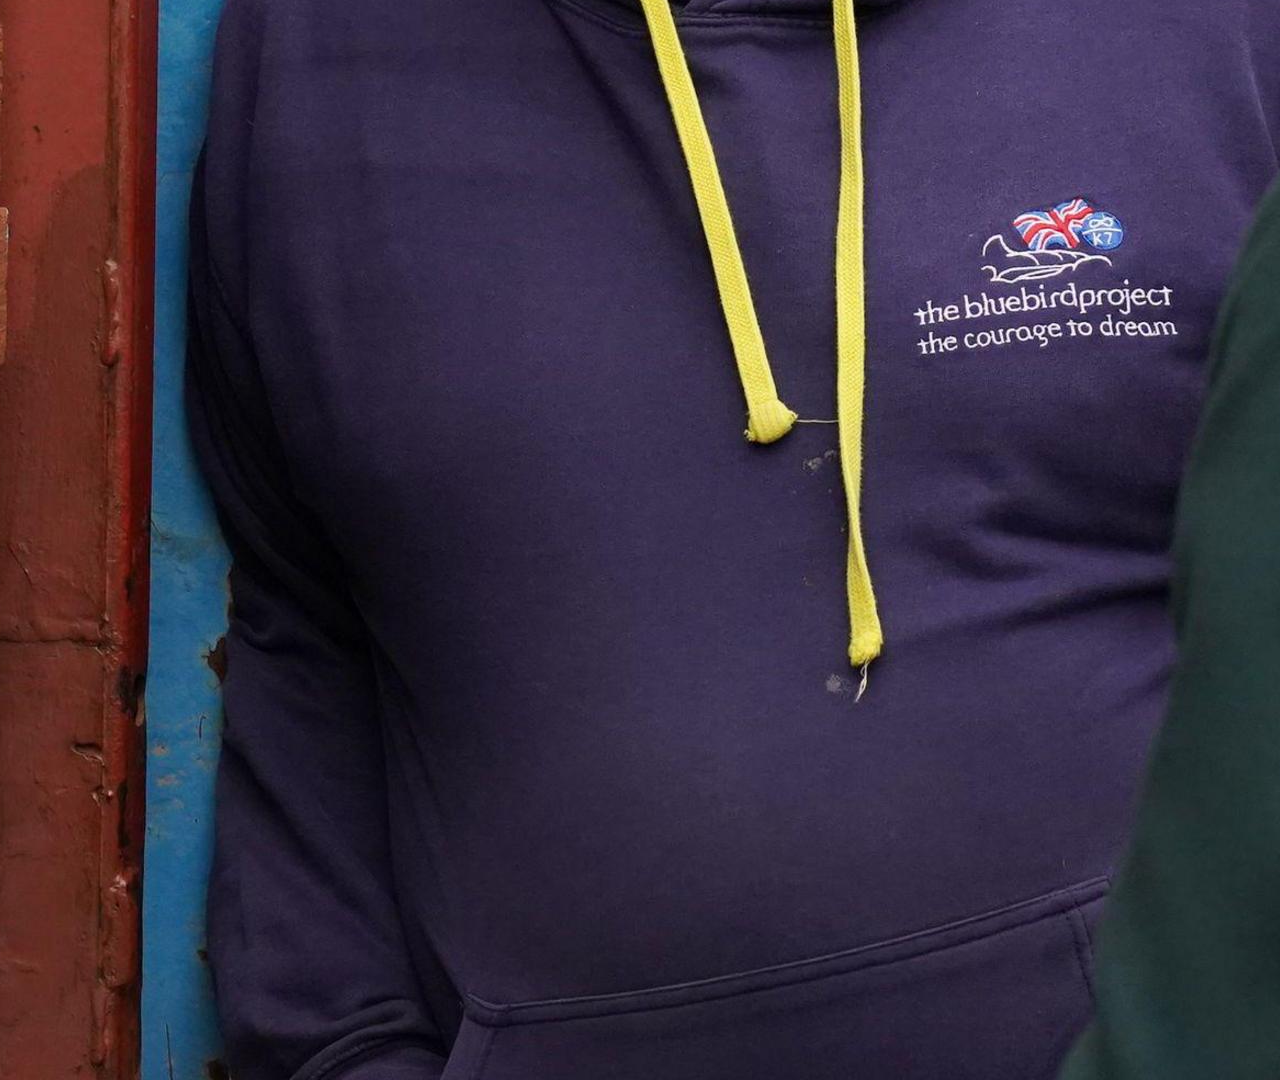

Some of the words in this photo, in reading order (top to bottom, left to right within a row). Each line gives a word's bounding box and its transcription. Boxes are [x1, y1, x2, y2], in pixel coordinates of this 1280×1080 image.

[1092, 230, 1113, 247] K7
[913, 300, 960, 326] the
[917, 331, 958, 355] the
[964, 321, 1063, 348] courage
[1066, 318, 1093, 337] to
[1100, 314, 1178, 337] dream
